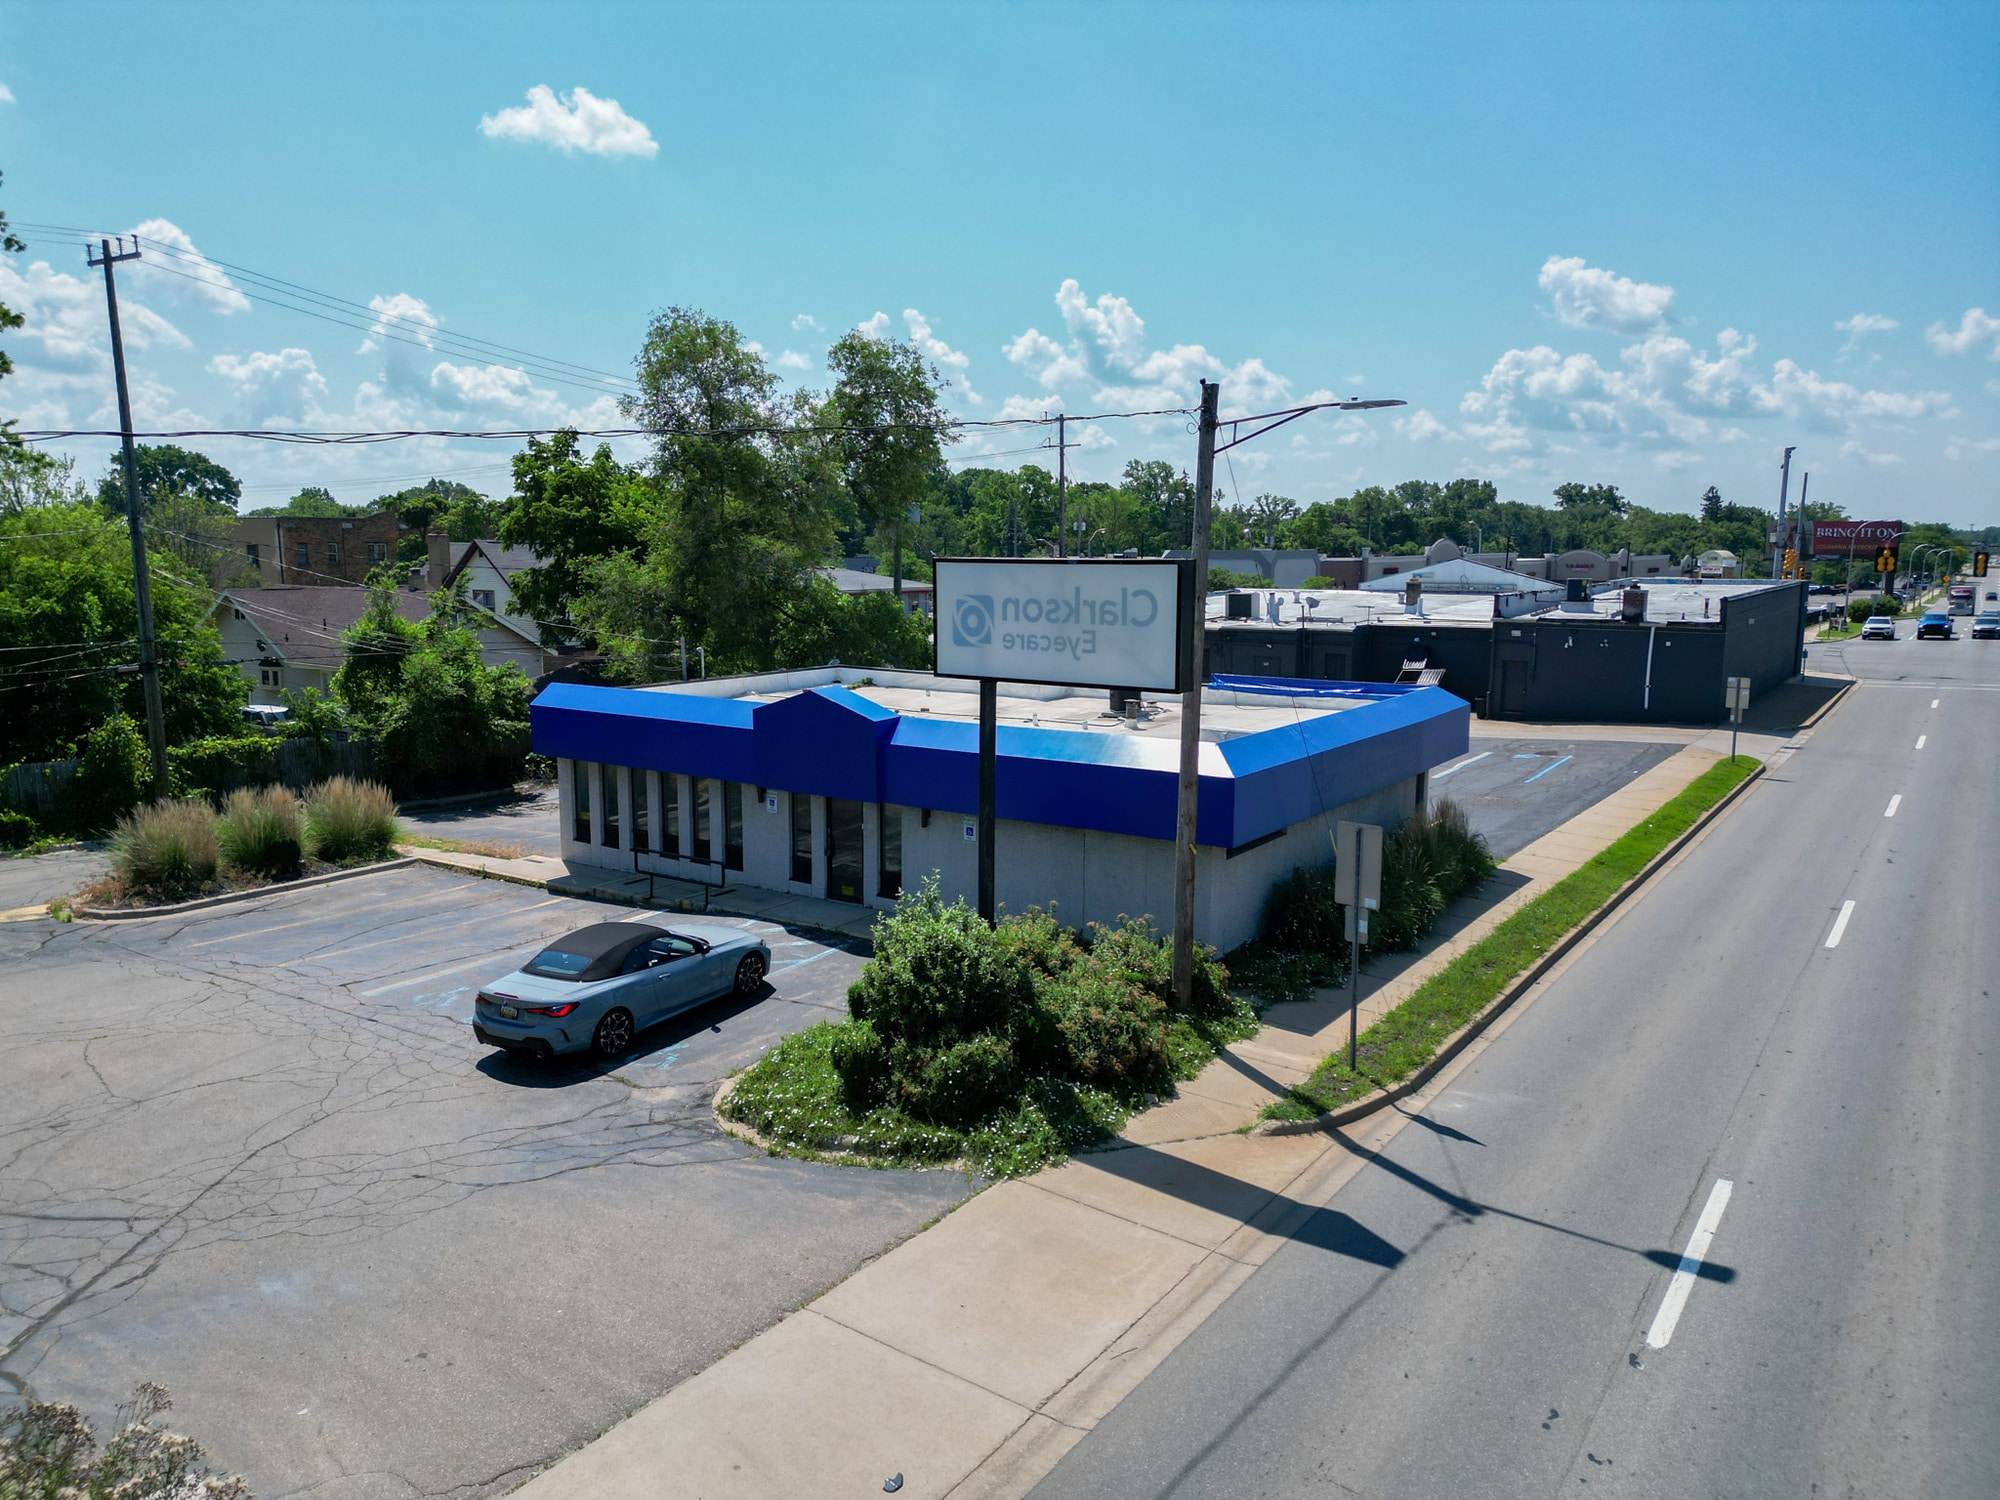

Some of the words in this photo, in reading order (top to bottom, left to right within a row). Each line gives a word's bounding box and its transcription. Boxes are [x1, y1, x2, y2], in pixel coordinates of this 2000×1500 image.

[1816, 527, 1856, 538] BRING
[1860, 527, 1875, 538] IT
[1876, 527, 1898, 538] ON
